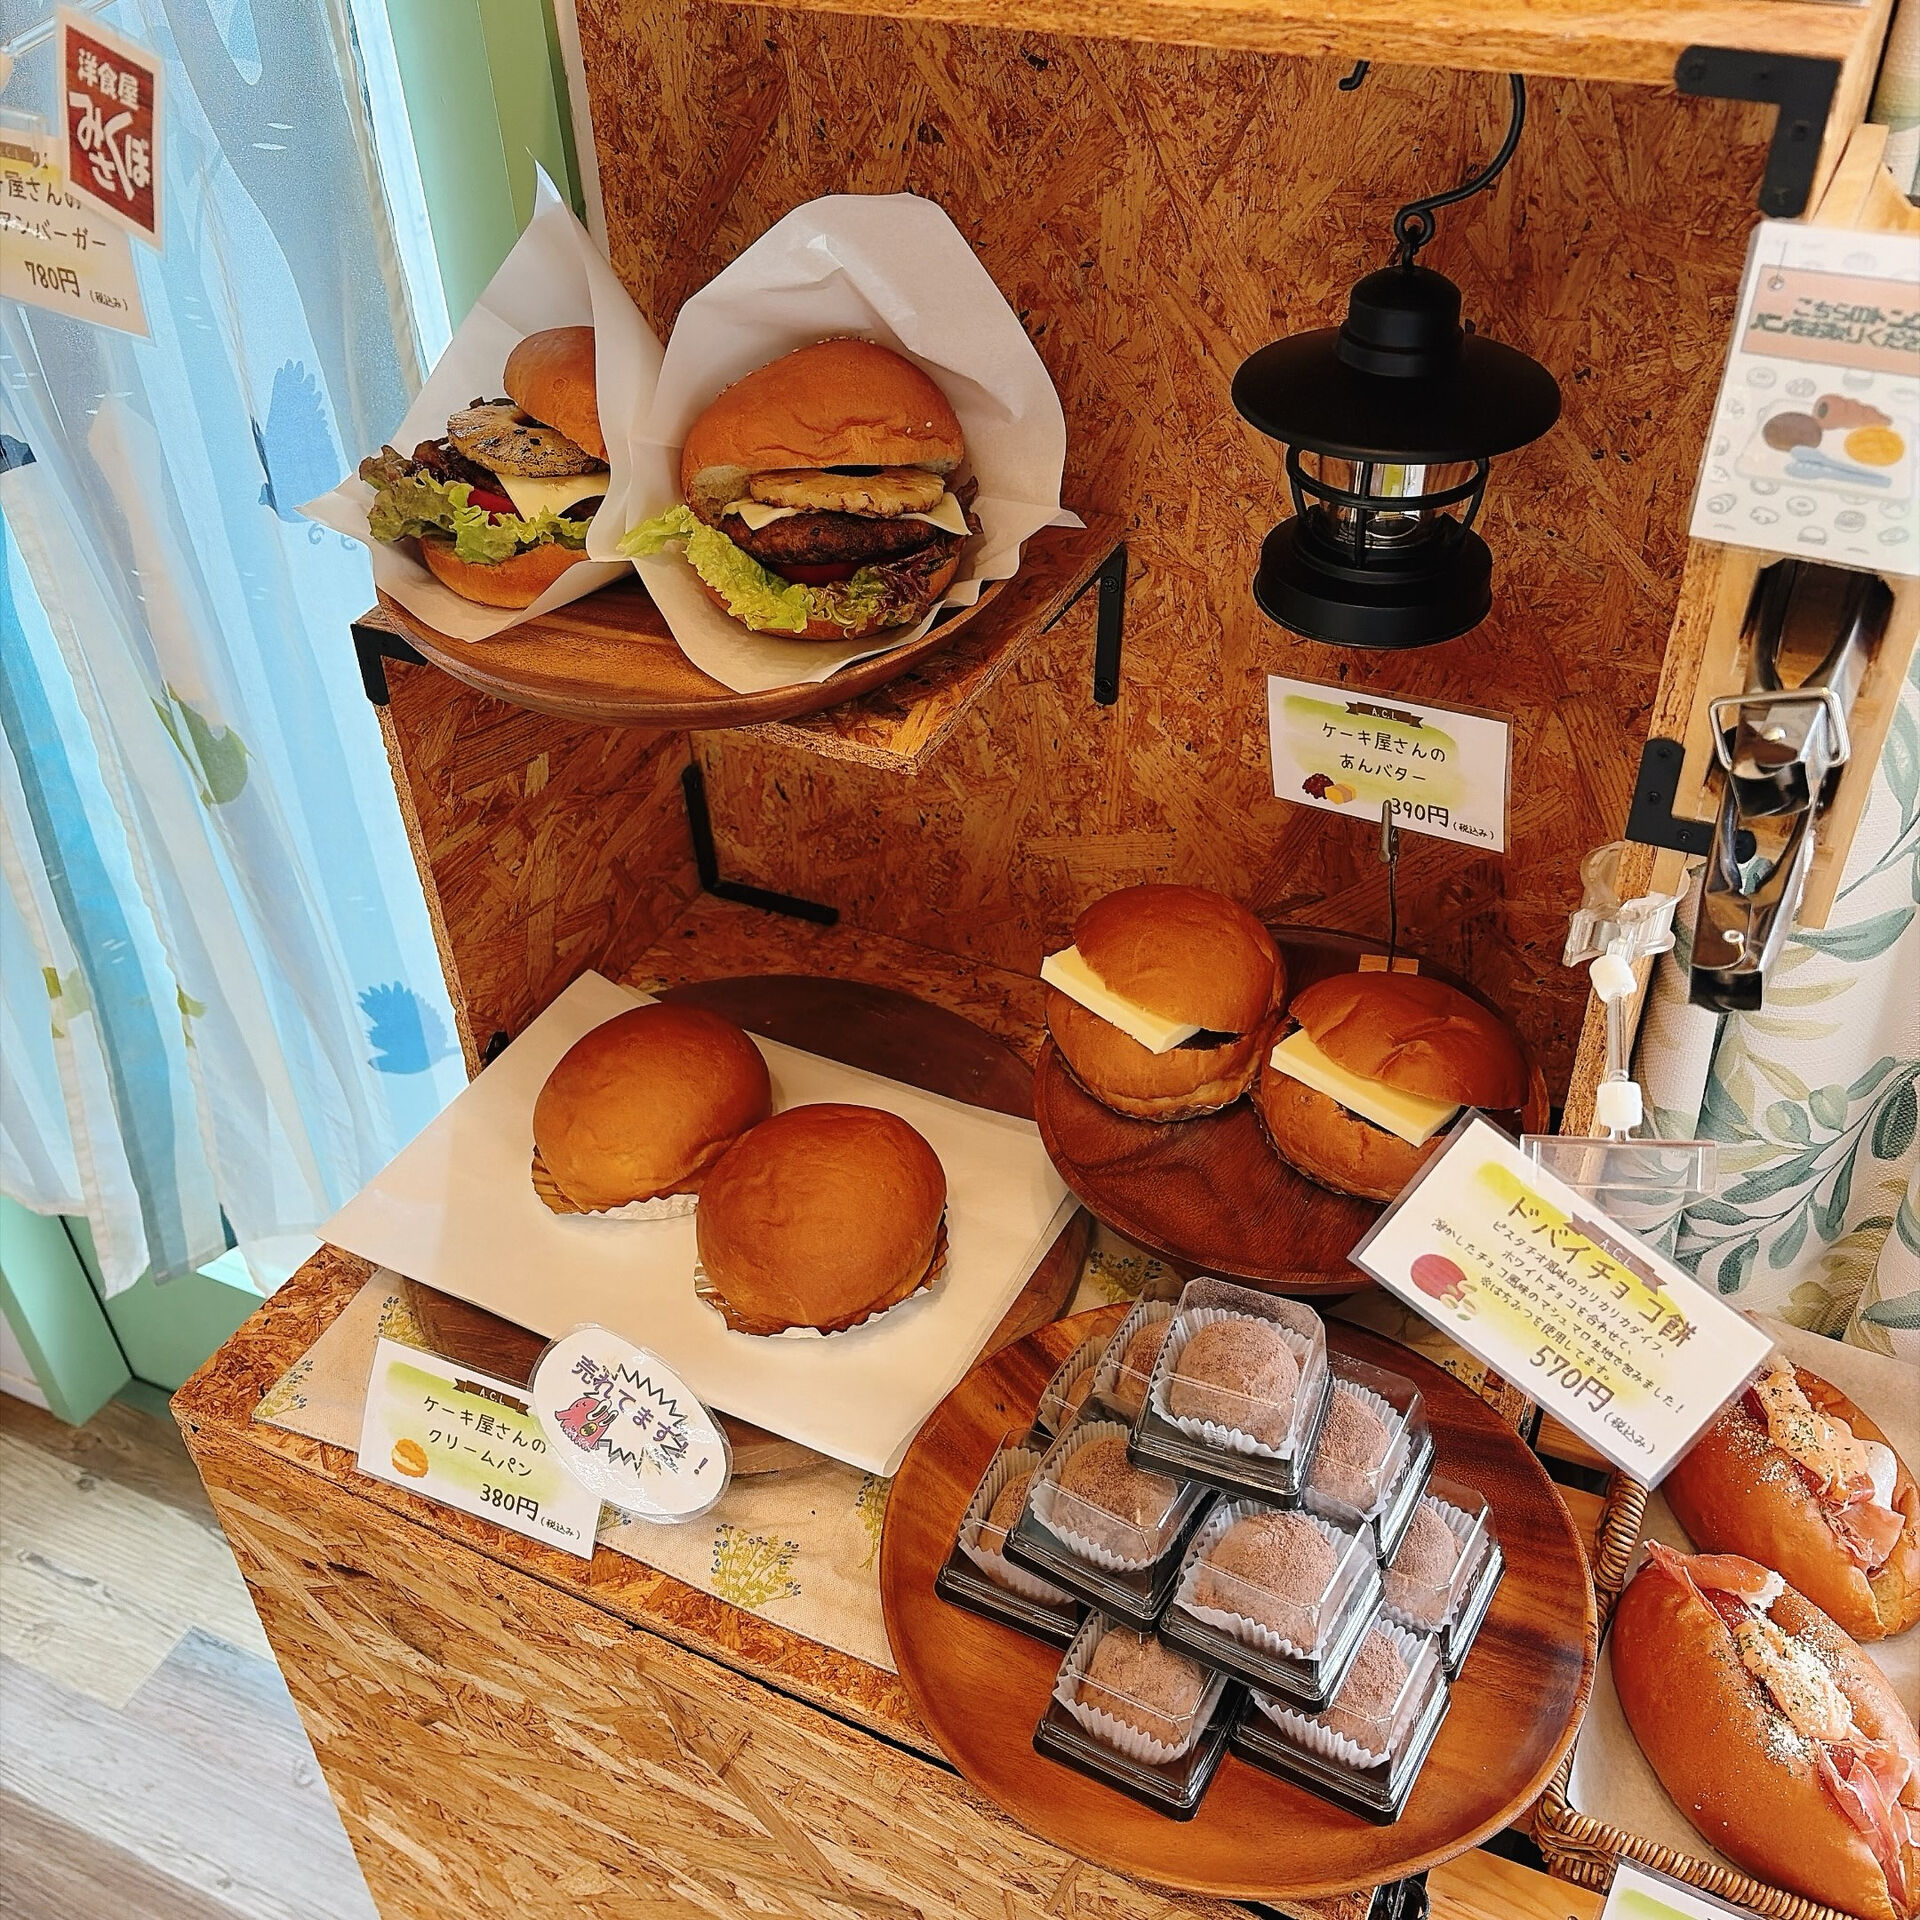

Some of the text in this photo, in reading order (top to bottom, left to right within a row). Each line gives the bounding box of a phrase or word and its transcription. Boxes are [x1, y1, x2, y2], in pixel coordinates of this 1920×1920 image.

[78, 48, 140, 110] 洋食屋
[24, 260, 80, 297] 780円
[1322, 722, 1446, 763] ケーキ屋さんの
[1339, 753, 1427, 782] あんバター
[1390, 798, 1449, 828] 390円
[1507, 1197, 1698, 1349] ドバイチョコ餅
[1501, 1250, 1632, 1355] ホワイトチョコを合わせて、
[1529, 1345, 1615, 1412] 570円
[422, 1395, 546, 1454] ケーキ屋さんの
[428, 1428, 533, 1477] クリームパン
[479, 1484, 540, 1521] 380円
